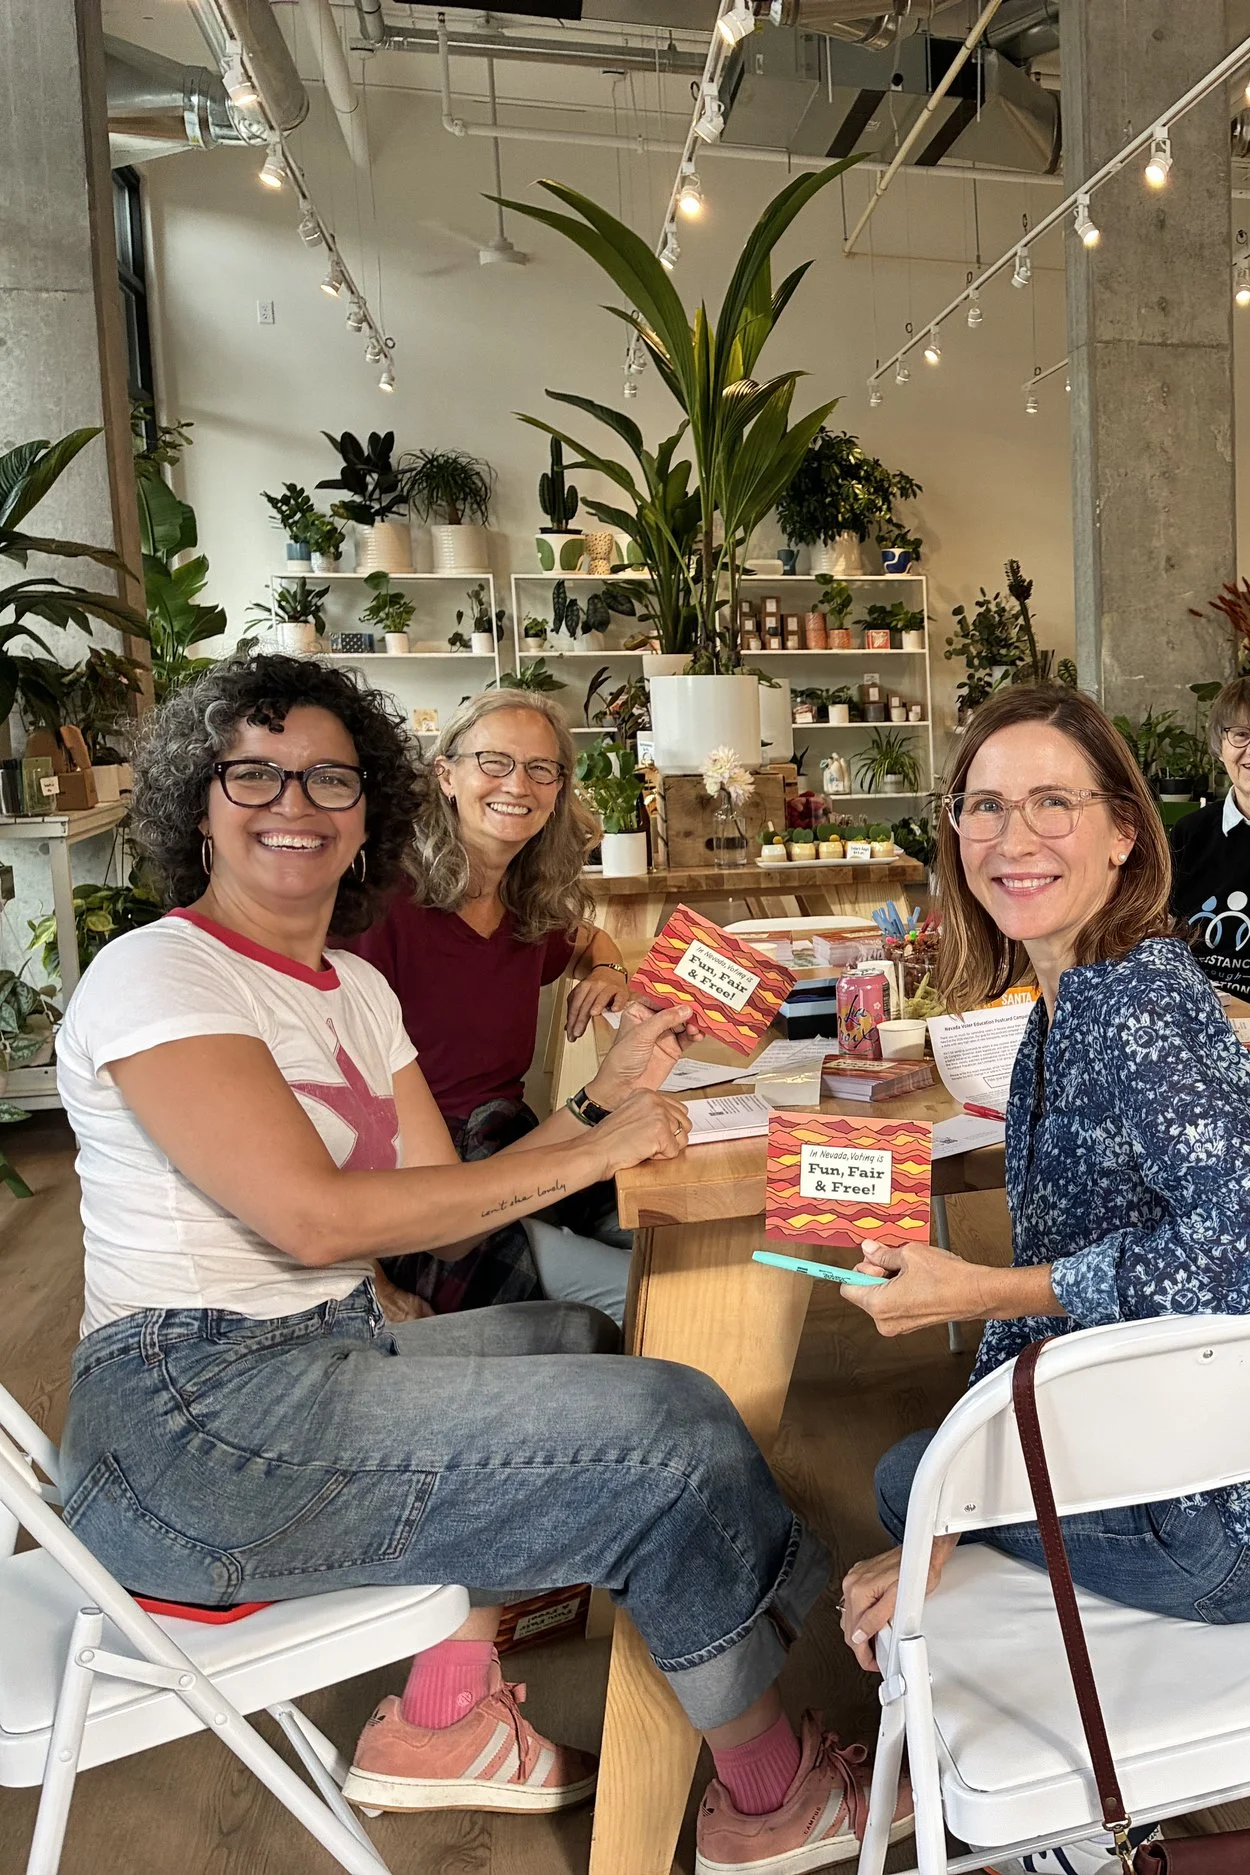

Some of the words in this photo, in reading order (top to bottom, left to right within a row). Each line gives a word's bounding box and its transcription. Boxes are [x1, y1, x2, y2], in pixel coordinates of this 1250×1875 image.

[696, 946, 704, 954] In
[704, 951, 727, 968] Nevada,
[727, 964, 747, 979] Voting
[689, 954, 717, 978] Fun,
[719, 972, 748, 994] Fair
[688, 969, 698, 980] &
[700, 975, 736, 1001] Free!
[1001, 991, 1033, 1005] SANTA
[973, 1019, 994, 1027] Education
[809, 1150, 818, 1158] In
[819, 1150, 849, 1161] Nevada,
[850, 1152, 875, 1164] Voting
[877, 1155, 884, 1163] is
[808, 1162, 845, 1178] Fun,
[848, 1166, 885, 1179] Fair
[537, 1179, 566, 1197] lovely
[815, 1180, 826, 1193] &
[831, 1181, 876, 1196] Free!
